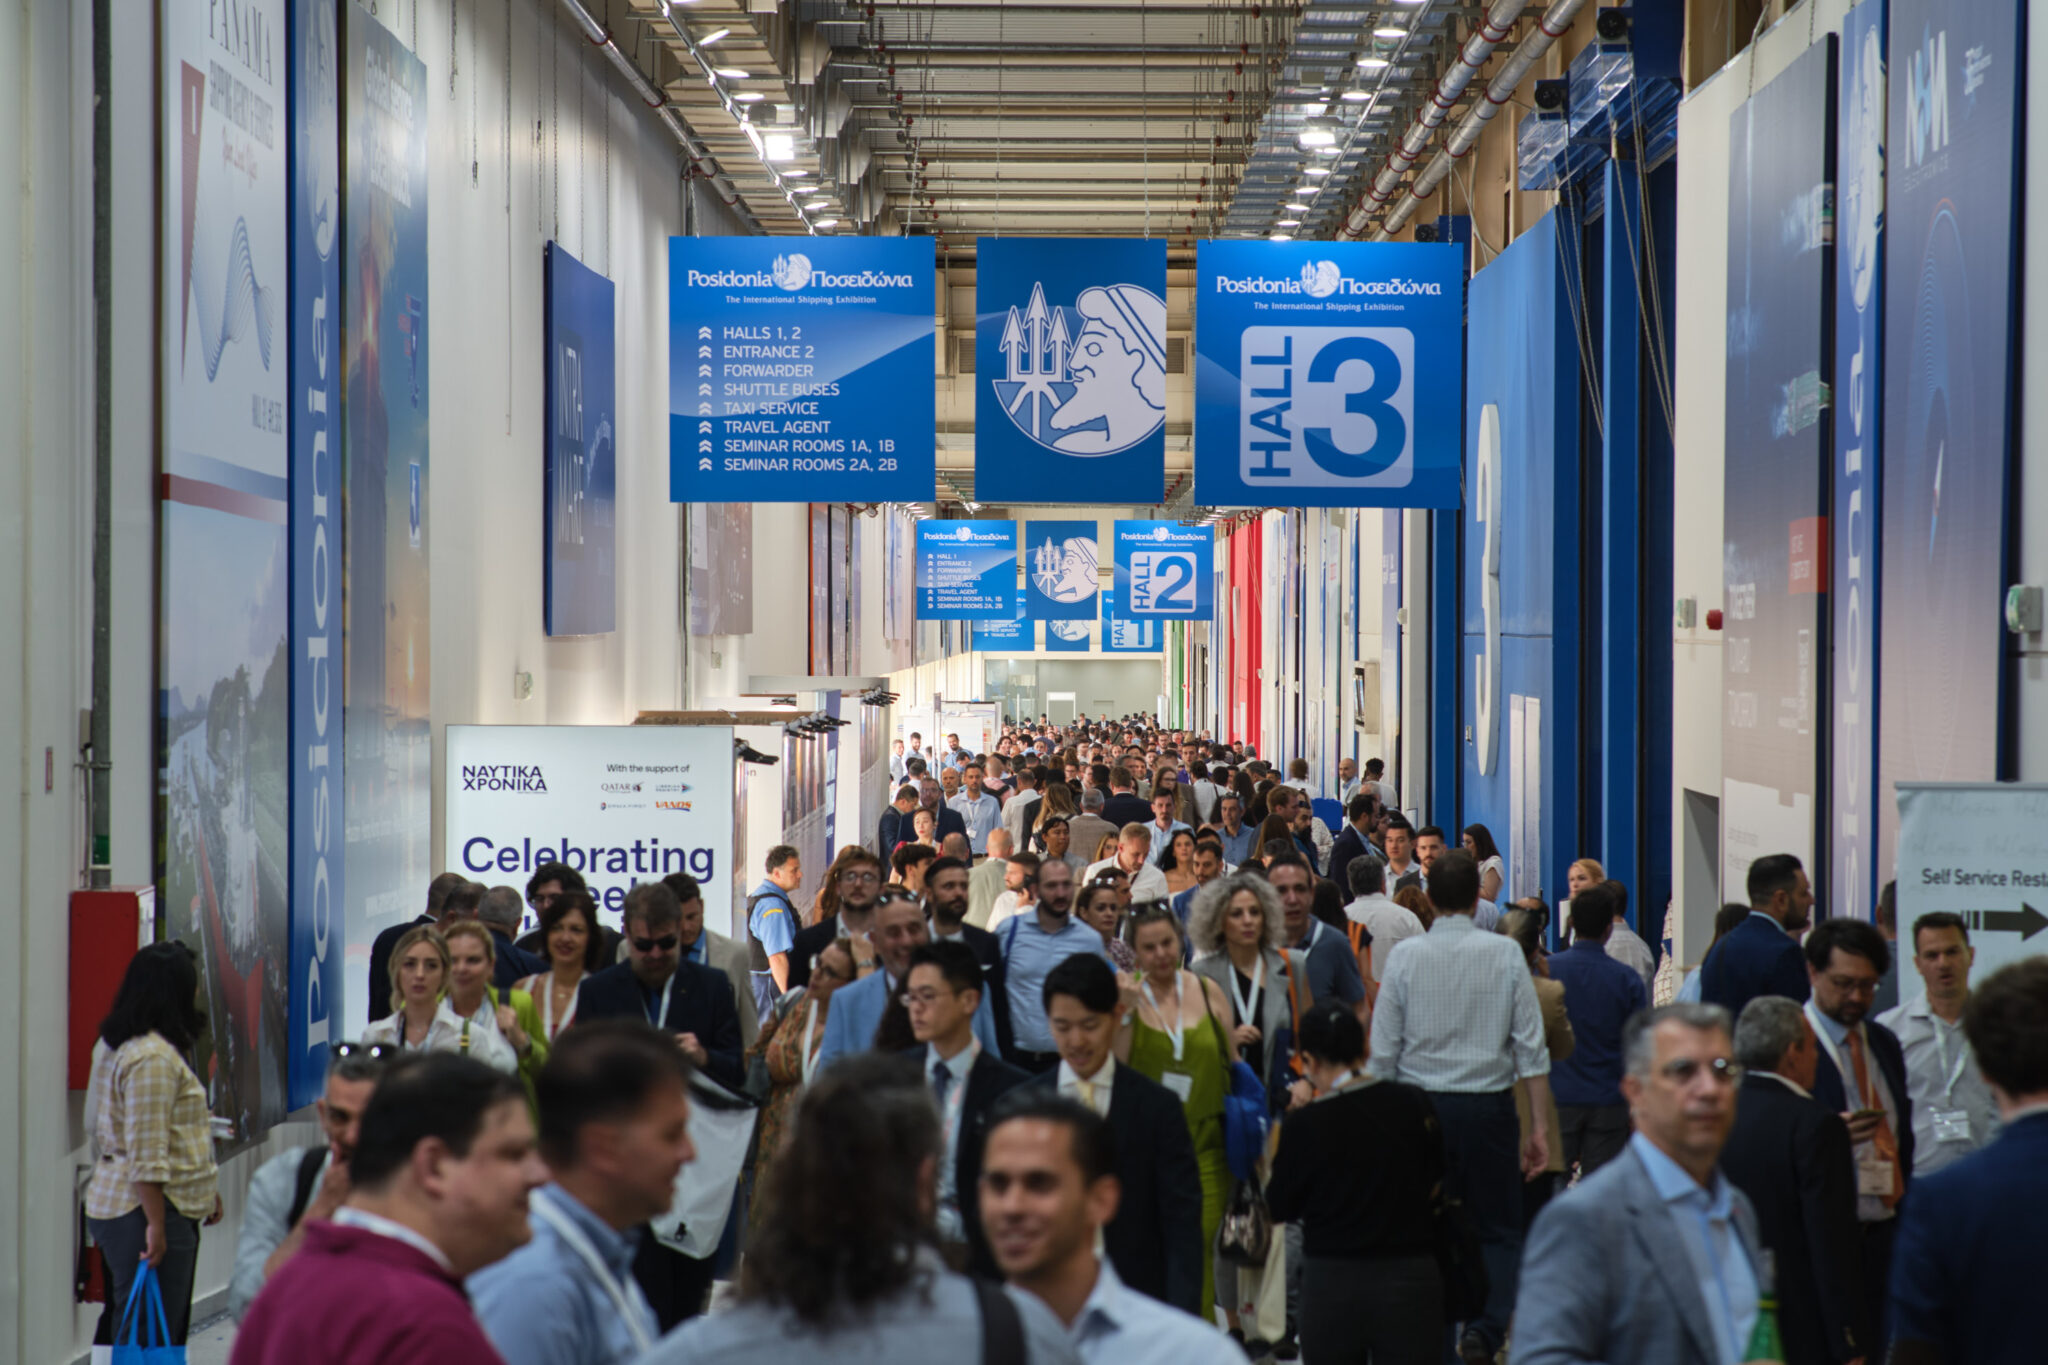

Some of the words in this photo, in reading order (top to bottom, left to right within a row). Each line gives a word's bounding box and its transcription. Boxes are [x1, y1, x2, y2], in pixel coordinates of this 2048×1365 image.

[687, 269, 772, 288] Posidonia
[811, 270, 914, 288] Ποσειδώνια
[1216, 275, 1300, 294] Posidonia
[1340, 277, 1442, 296] Ποσειδώνια
[725, 295, 741, 304] The
[743, 295, 796, 304] International
[798, 295, 834, 306] Shipping
[836, 295, 877, 304] Exhibition
[1253, 302, 1269, 310] The
[1271, 302, 1324, 311] International
[1326, 302, 1362, 313] Shipping
[1364, 302, 1405, 311] Exhibition
[723, 326, 772, 340] HALLS
[777, 326, 788, 341] 1,
[791, 326, 802, 340] 2
[723, 345, 801, 359] ENTRANCE
[804, 345, 814, 359] 2
[723, 364, 814, 377] FORWARDER
[559, 342, 584, 443] INTRA
[723, 383, 788, 396] SHUTTLE
[791, 383, 840, 396] BUSES
[723, 402, 758, 415] TAXI
[761, 402, 819, 415] SERVICE
[1249, 335, 1292, 478] HALL
[1303, 336, 1407, 479] 3
[723, 420, 780, 434] TRAVEL
[782, 420, 832, 434] AGENT
[723, 439, 789, 453] SEMINAR
[792, 439, 846, 453] ROOMS
[851, 439, 872, 454] 1A,
[878, 439, 896, 453] 1B
[723, 458, 789, 472] SEMINAR
[792, 458, 846, 472] ROOMS
[849, 458, 874, 473] 2A,
[877, 458, 898, 471] 2B
[559, 451, 584, 545] MARE
[924, 532, 957, 541] Posidonia
[1121, 532, 1154, 541] Posidonia
[1134, 555, 1151, 609] HALL
[1154, 555, 1193, 609] 2
[1114, 619, 1124, 646] HAL
[1842, 335, 1864, 918] sidonia
[307, 285, 330, 1052] Posidonia
[607, 763, 627, 773] With
[629, 763, 643, 773] the
[645, 764, 679, 775] support
[680, 763, 690, 773] of
[601, 783, 631, 792] QATAR
[462, 836, 715, 884] Celebrating
[1921, 867, 1952, 885] Self
[1954, 869, 2007, 887] Service
